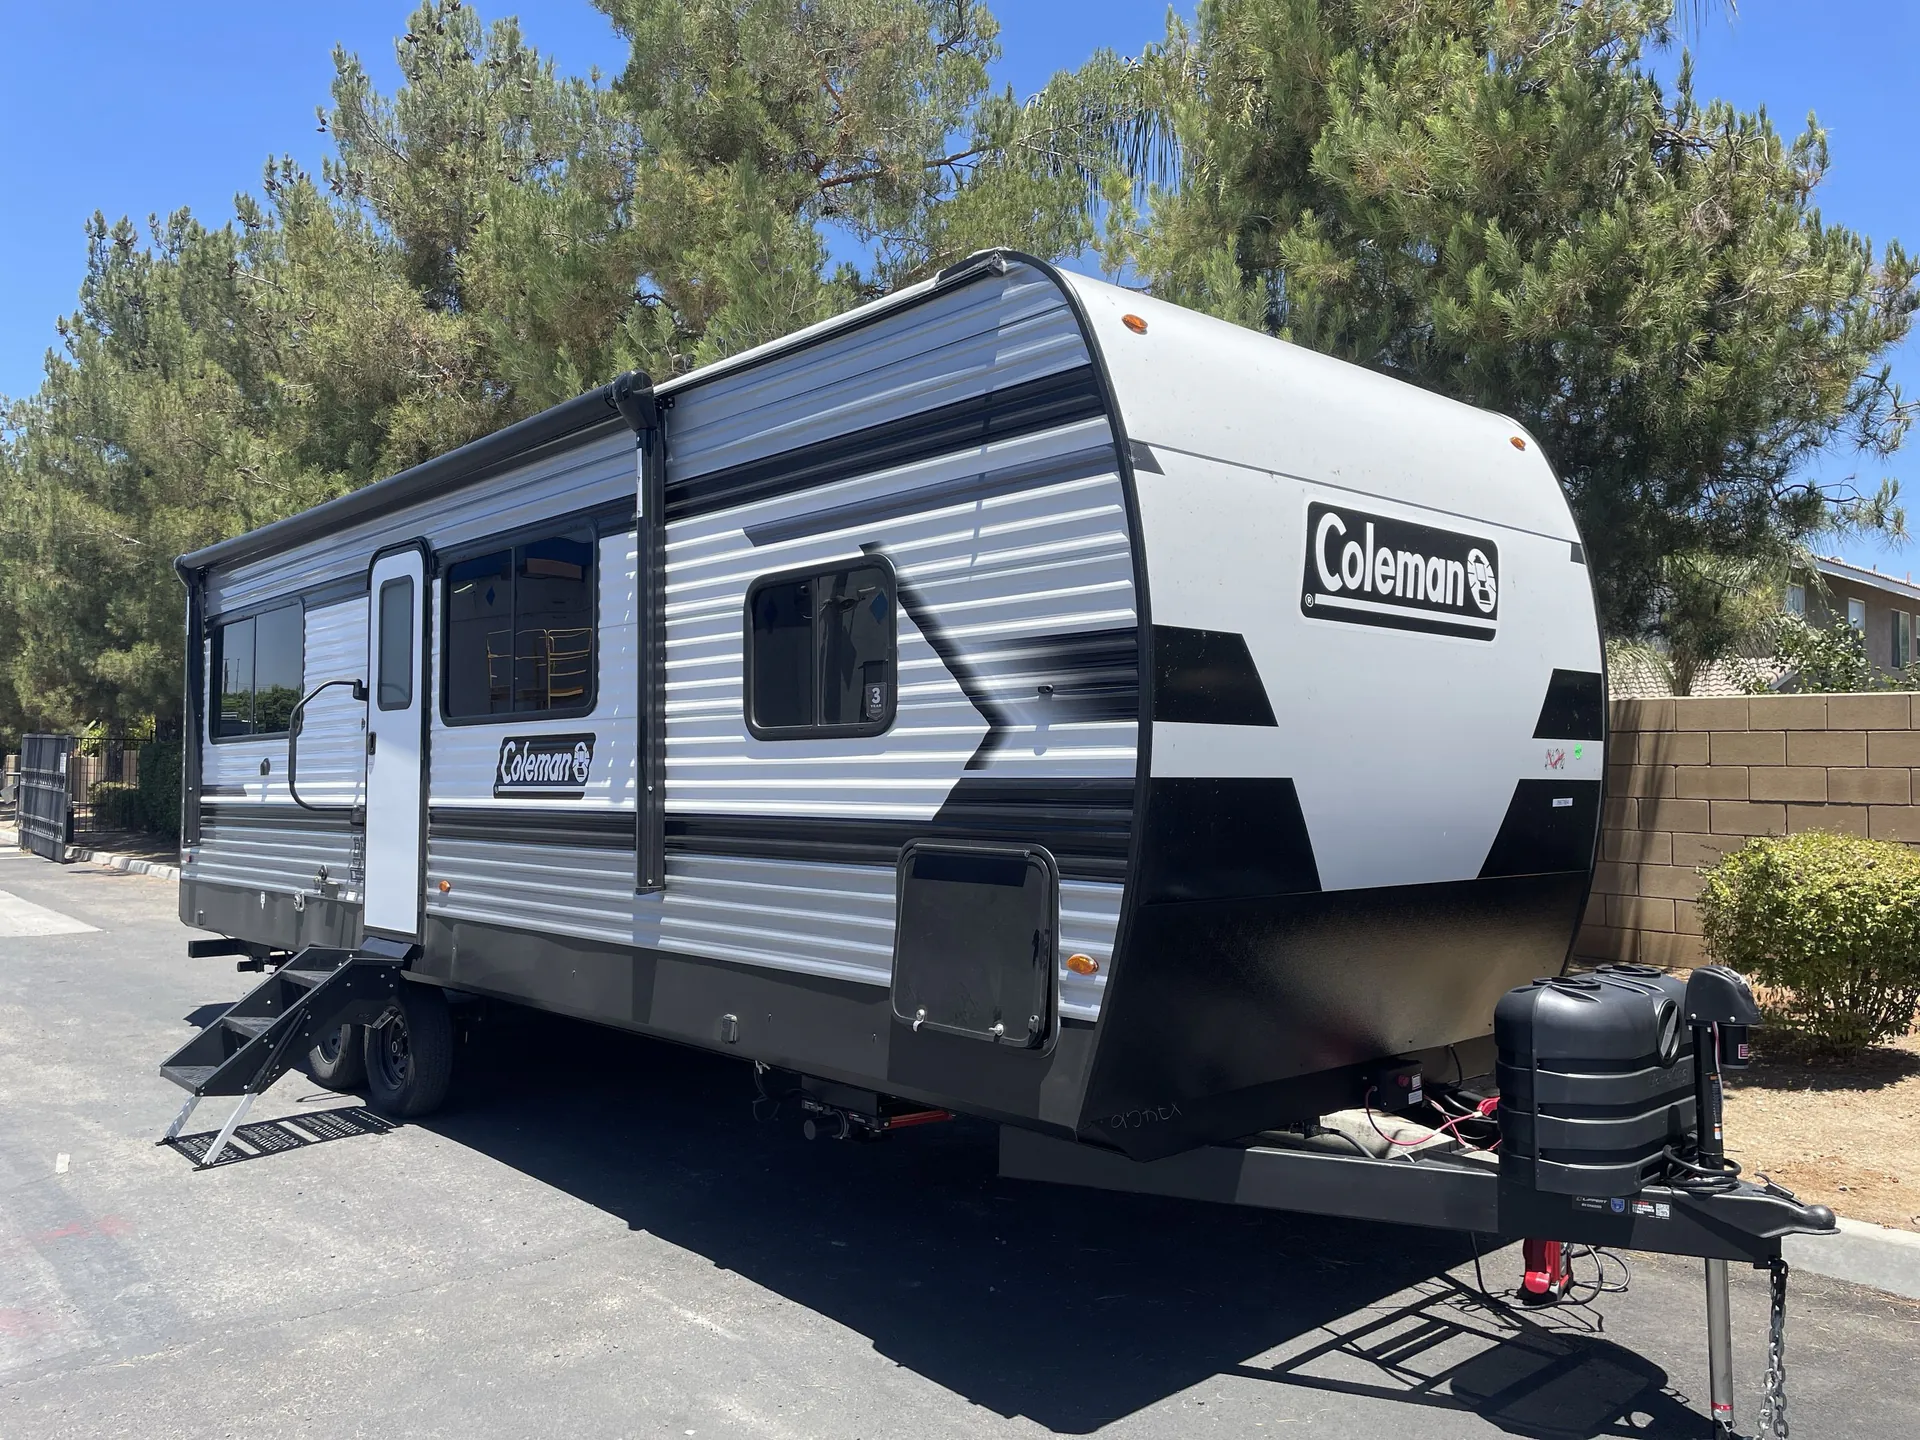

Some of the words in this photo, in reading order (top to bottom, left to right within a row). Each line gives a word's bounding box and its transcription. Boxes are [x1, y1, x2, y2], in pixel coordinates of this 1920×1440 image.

[1315, 512, 1465, 607] Coleman
[871, 687, 881, 704] 3
[500, 740, 573, 784] Coleman
